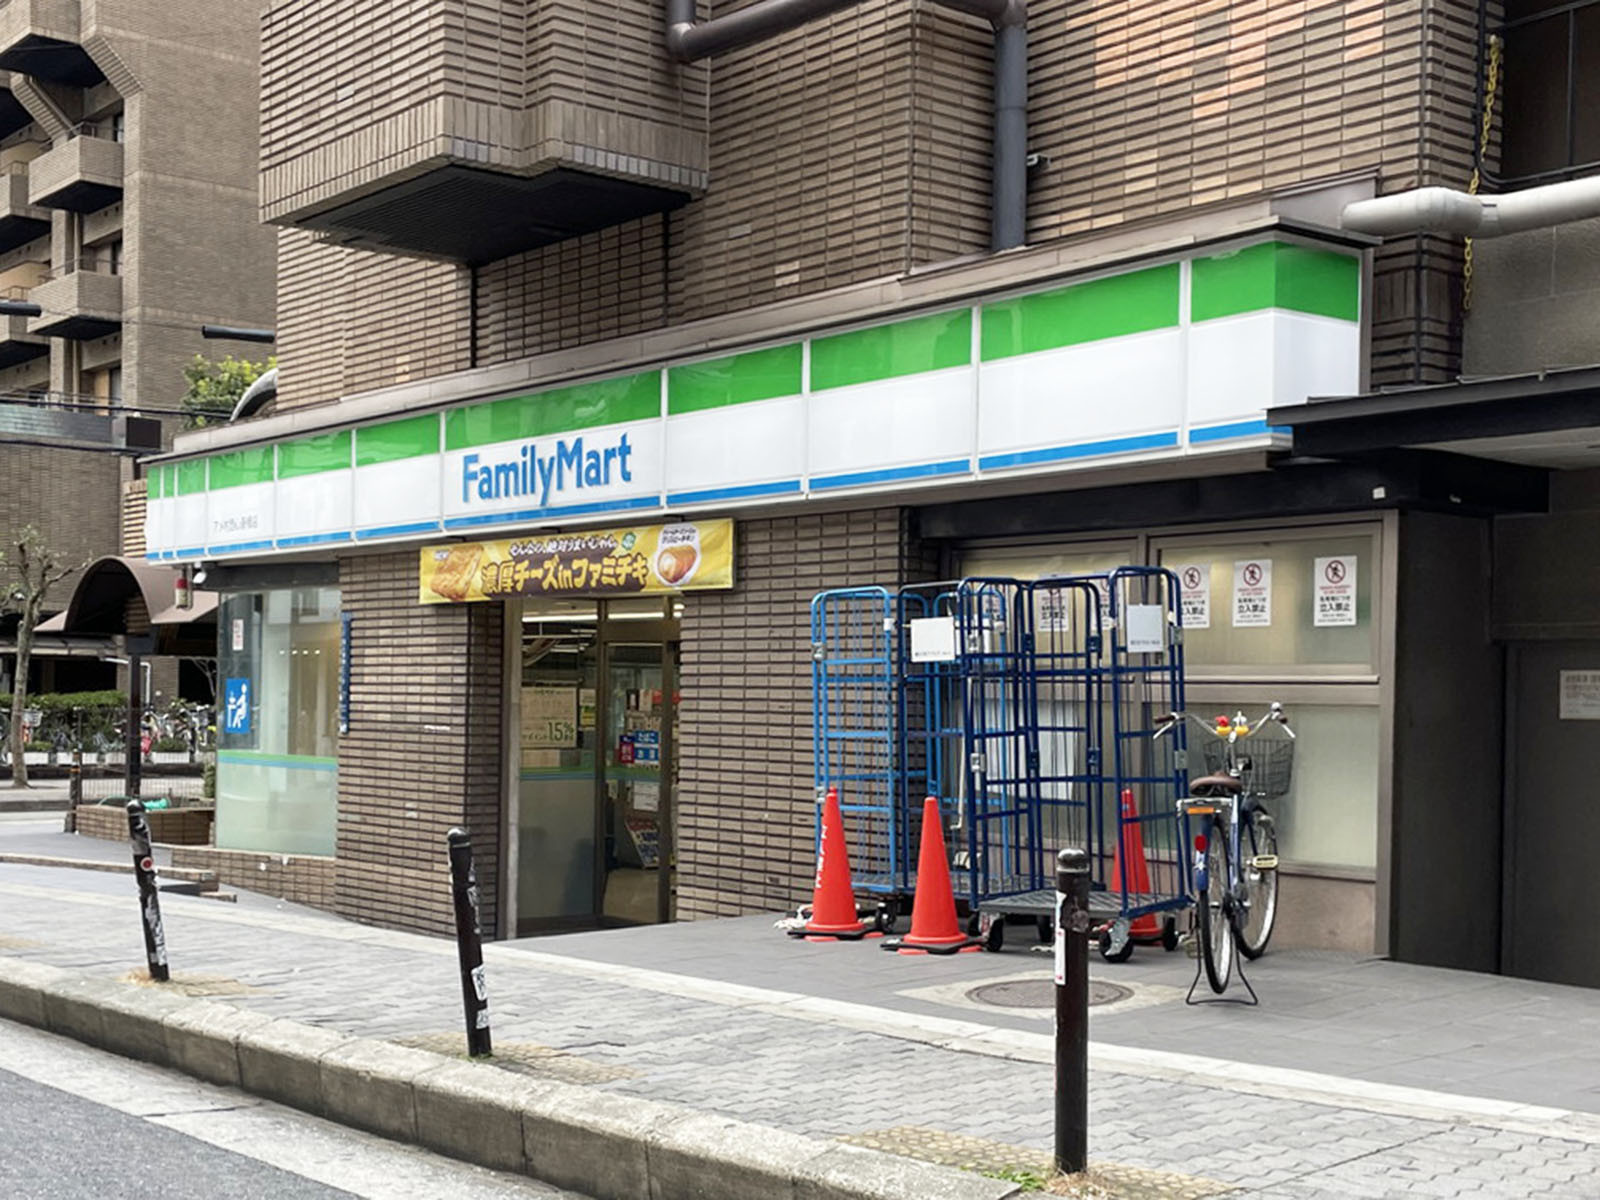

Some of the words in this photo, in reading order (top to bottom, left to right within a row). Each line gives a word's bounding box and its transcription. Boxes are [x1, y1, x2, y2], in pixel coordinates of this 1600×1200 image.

[462, 432, 632, 507] FamilyMart
[482, 552, 648, 594] 濃厚チーズinファミチキ
[1181, 607, 1205, 615] 入禁止
[1238, 605, 1266, 613] 立入禁止
